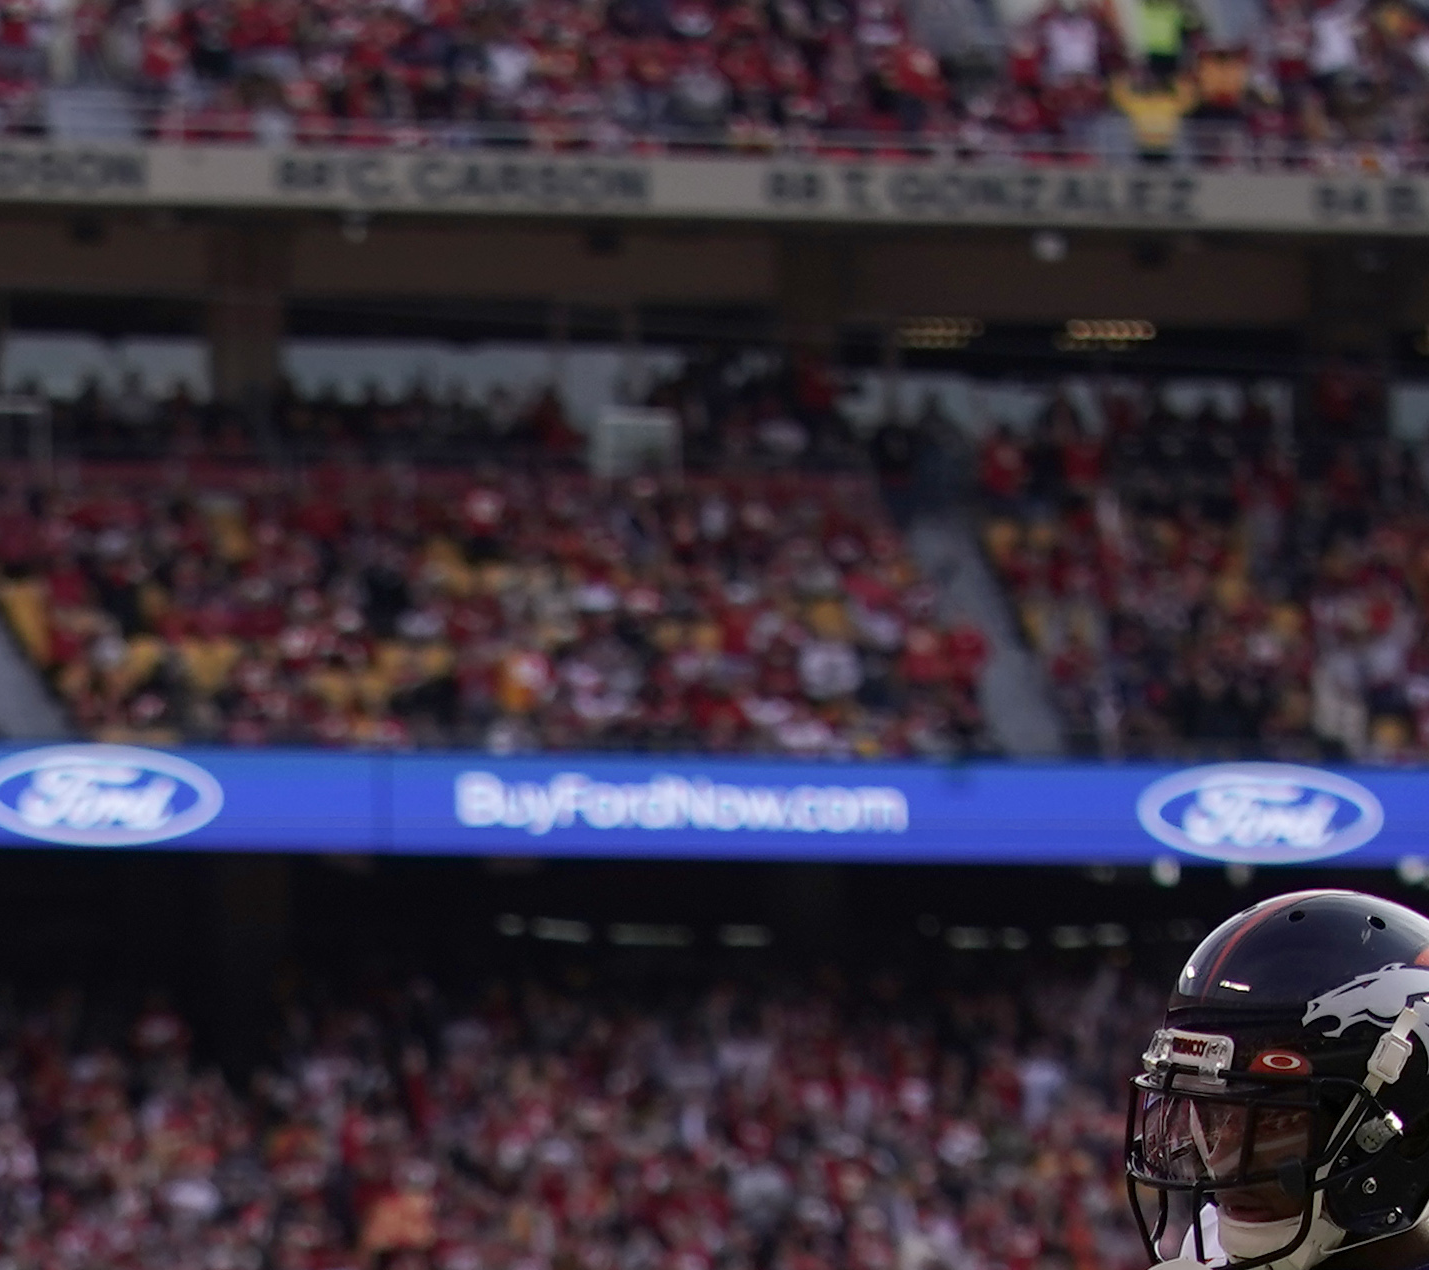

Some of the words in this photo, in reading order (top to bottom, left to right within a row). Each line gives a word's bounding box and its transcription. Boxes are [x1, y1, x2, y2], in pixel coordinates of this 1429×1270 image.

[408, 159, 653, 202] CARSON
[886, 171, 1204, 219] GONZALEZ
[17, 753, 181, 829] Ford
[453, 769, 909, 840] BuyFordNow.com
[1182, 774, 1342, 847] Ford
